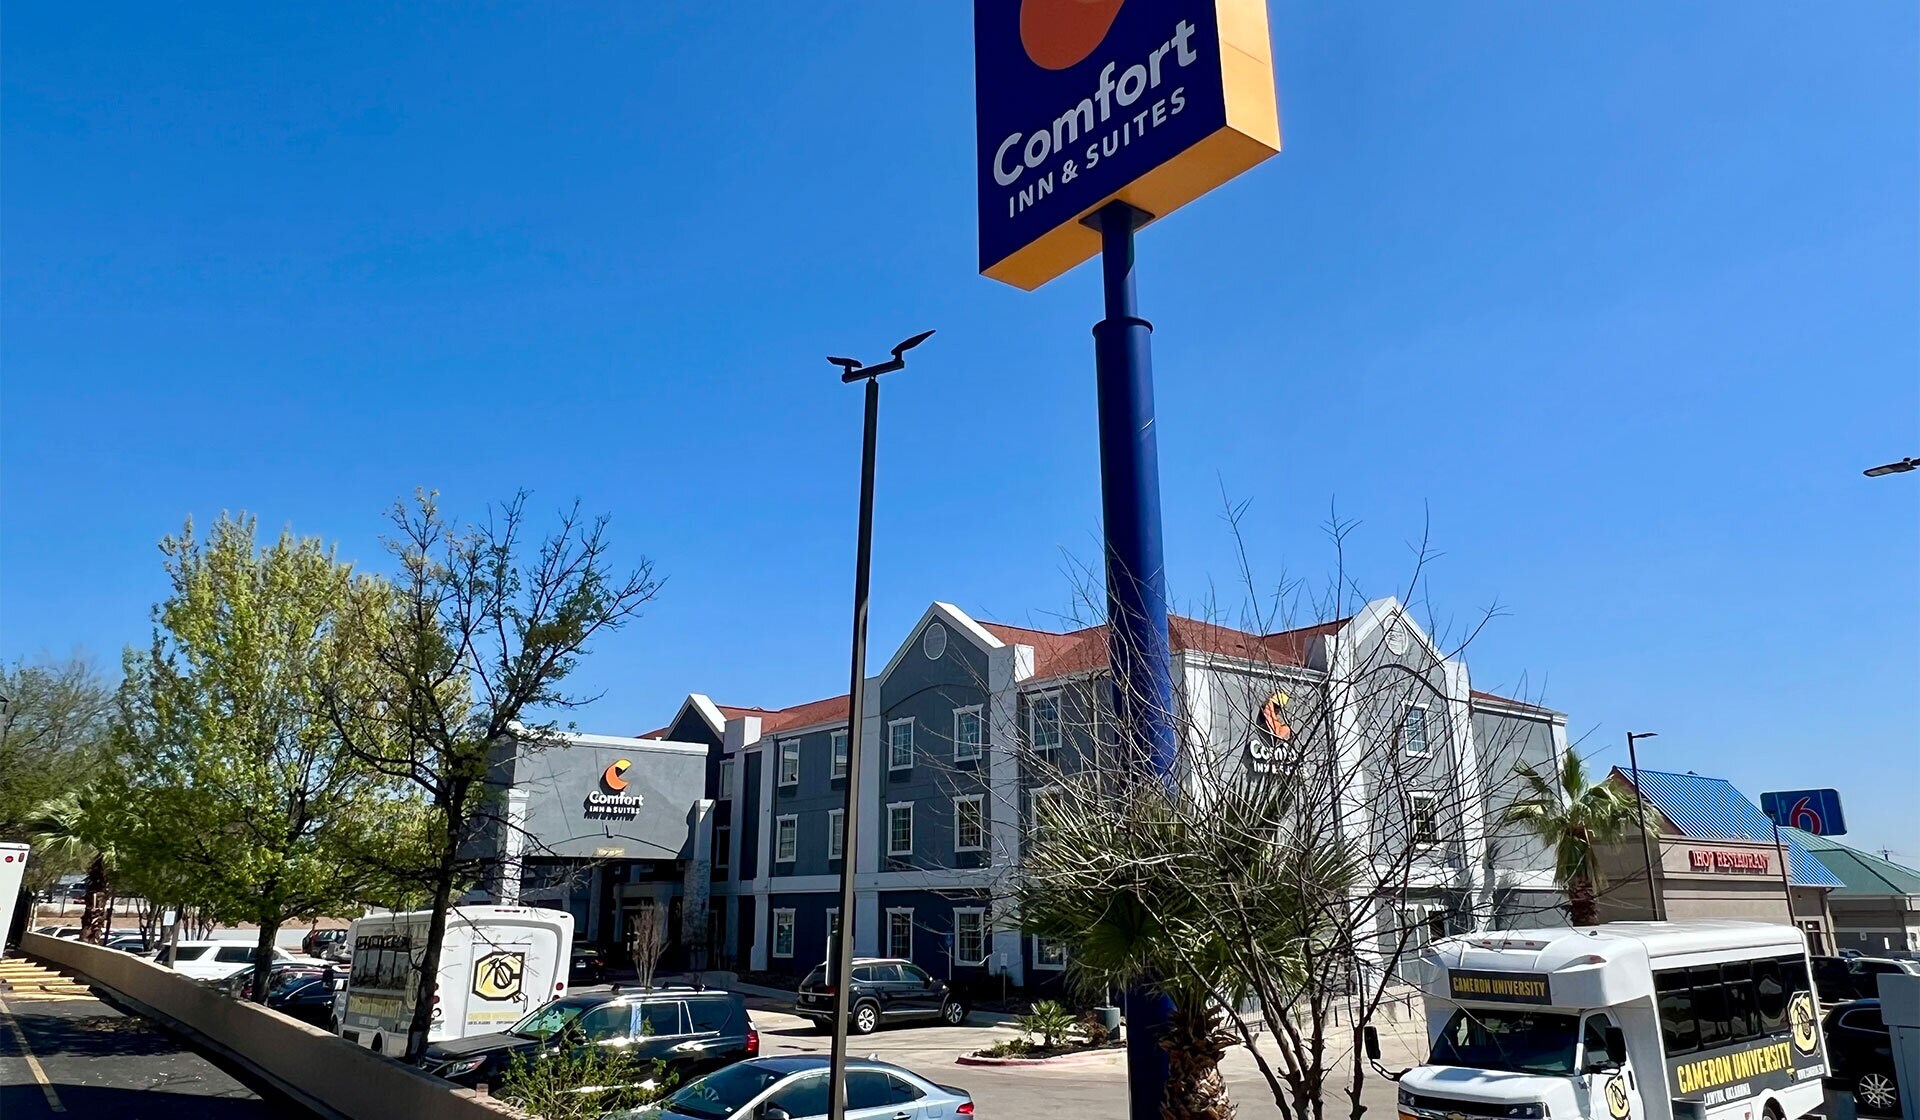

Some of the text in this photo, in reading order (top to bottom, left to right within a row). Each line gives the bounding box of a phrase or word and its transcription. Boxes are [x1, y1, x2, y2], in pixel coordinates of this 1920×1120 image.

[993, 19, 1197, 186] Comfort
[1009, 87, 1186, 218] INN & SUITES
[589, 791, 644, 806] Comfort
[589, 805, 605, 813] INN
[613, 806, 640, 814] SUITES
[1790, 796, 1822, 836] 6
[1715, 851, 1770, 869] RESTAURANT
[1453, 977, 1545, 997] CAMERON UNIVERSITY
[1677, 1055, 1734, 1094] CAMERON
[1732, 1041, 1792, 1080] UNIVERSITY
